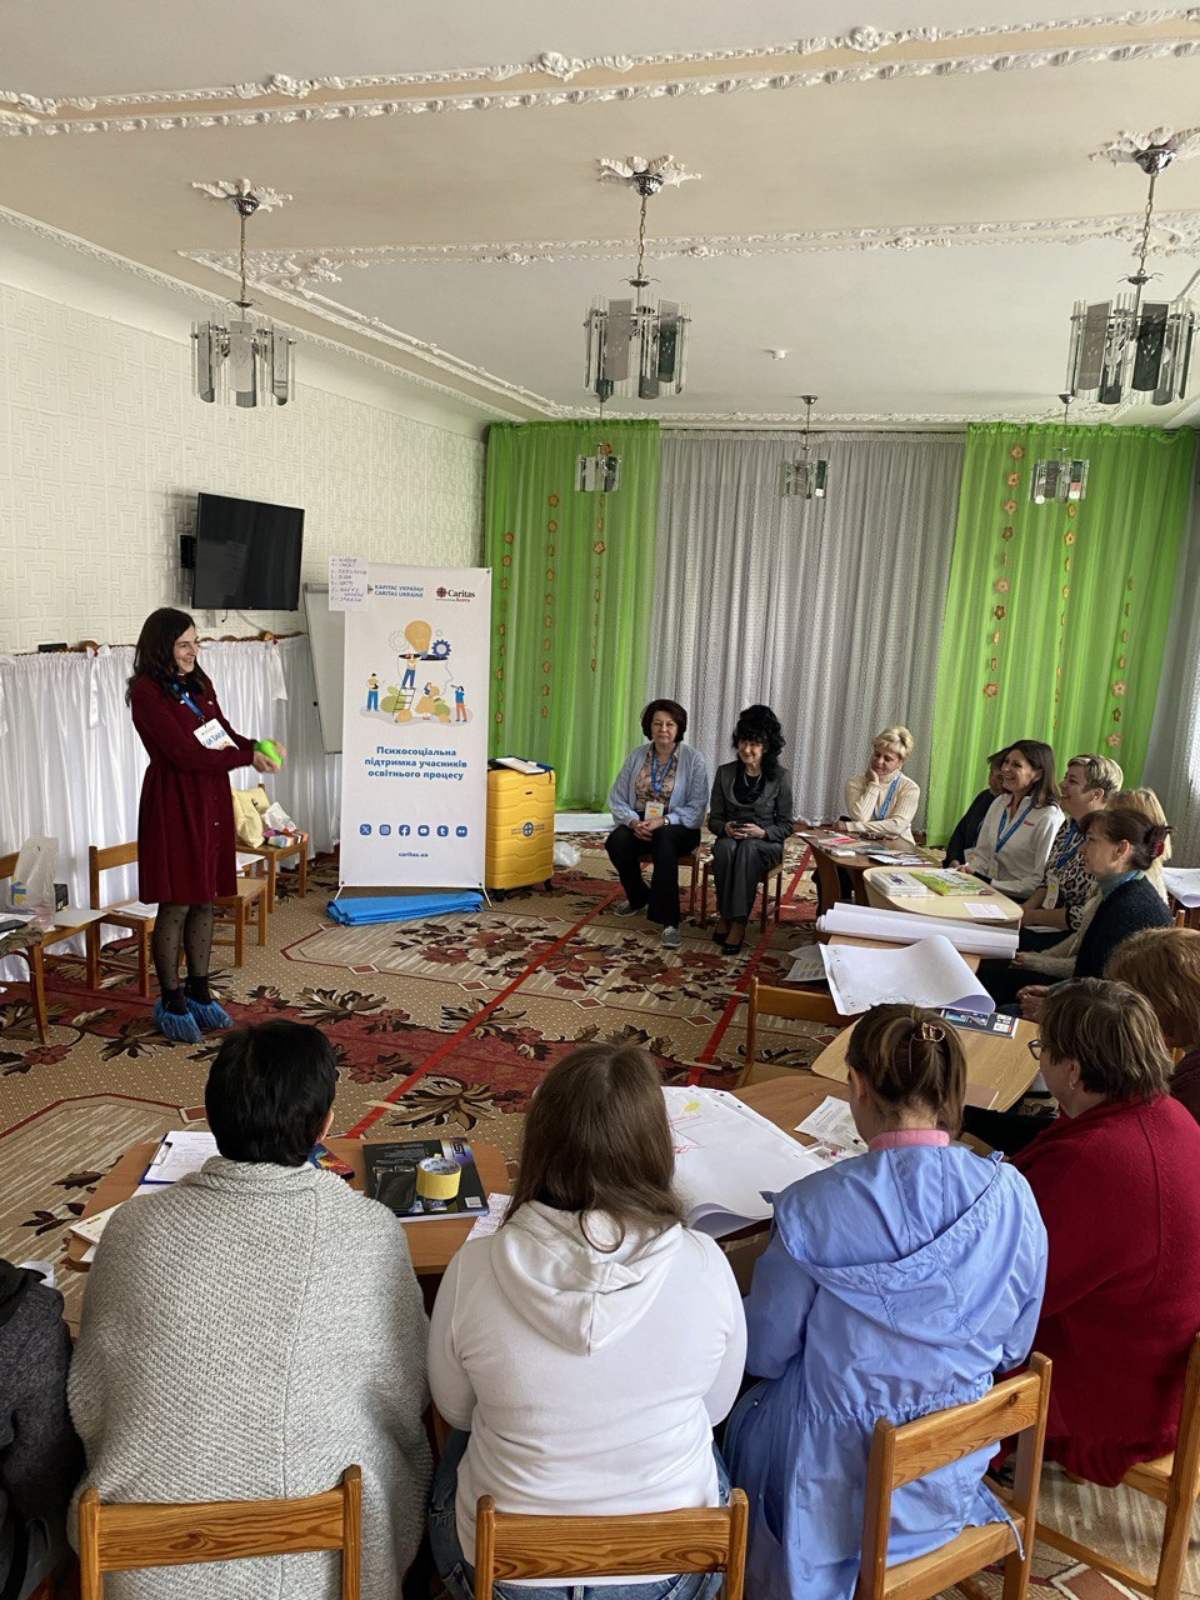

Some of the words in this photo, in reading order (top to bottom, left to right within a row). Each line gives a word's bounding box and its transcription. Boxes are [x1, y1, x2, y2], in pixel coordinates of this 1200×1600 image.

[447, 589, 476, 598] Caritas
[376, 746, 457, 756] Психосоціальна
[364, 757, 417, 767] підтримка
[419, 760, 467, 769] учасників
[368, 769, 421, 778] освітнього
[423, 771, 464, 781] процесу
